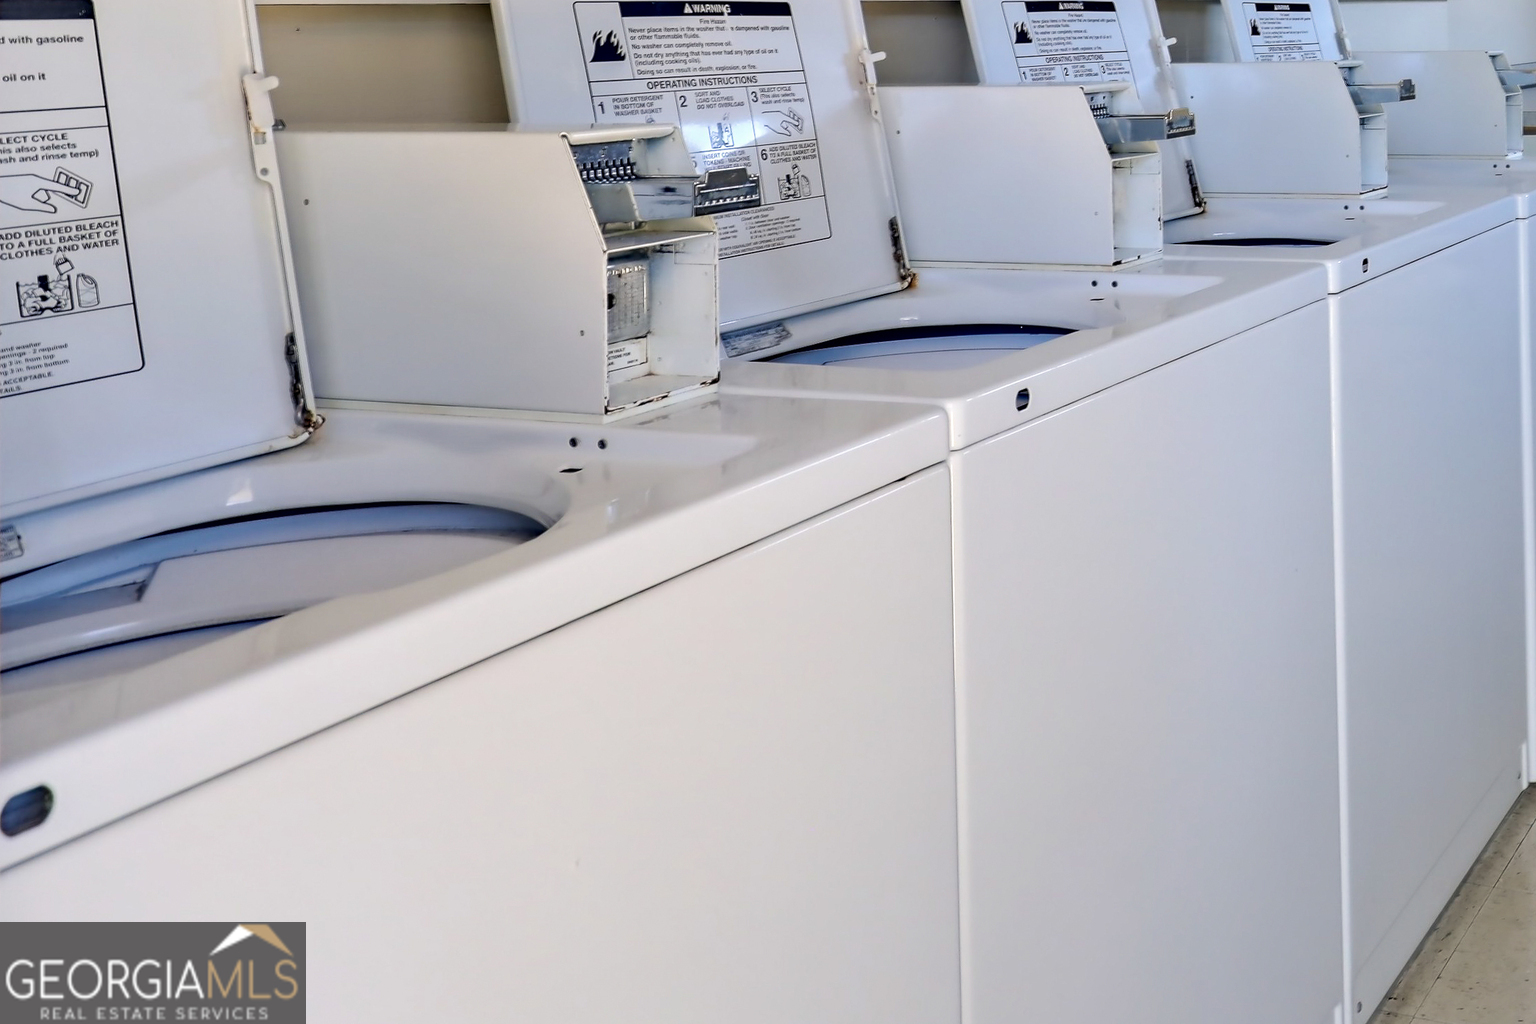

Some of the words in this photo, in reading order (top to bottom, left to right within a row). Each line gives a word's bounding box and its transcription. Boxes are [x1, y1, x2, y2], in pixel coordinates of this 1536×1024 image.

[691, 4, 731, 14] WARNING
[8, 36, 33, 44] with
[36, 35, 84, 46] gasoline
[1022, 71, 1027, 80] 1
[1063, 67, 1069, 77] 2
[1101, 65, 1106, 74] 3
[2, 73, 17, 82] oil
[20, 74, 35, 82] on
[38, 72, 46, 81] it
[646, 79, 697, 90] OPERATING
[699, 76, 758, 86] INSTRUCTIONS
[679, 95, 688, 108] 2
[751, 91, 759, 103] 3
[598, 101, 605, 114] 1
[31, 133, 68, 143] CYCLE
[40, 142, 77, 151] selects
[19, 154, 39, 163] and
[42, 152, 67, 160] rinse
[70, 148, 99, 159] temp)
[761, 149, 768, 161] 6
[25, 225, 72, 238] DILUTED
[75, 220, 119, 232] BLEACH
[0, 242, 14, 251] TO
[28, 237, 56, 247] FULL
[59, 231, 102, 243] BASKET
[104, 229, 118, 238] OF
[0, 247, 53, 261] CLOTHES
[56, 243, 79, 253] AND
[82, 238, 119, 250] WATER
